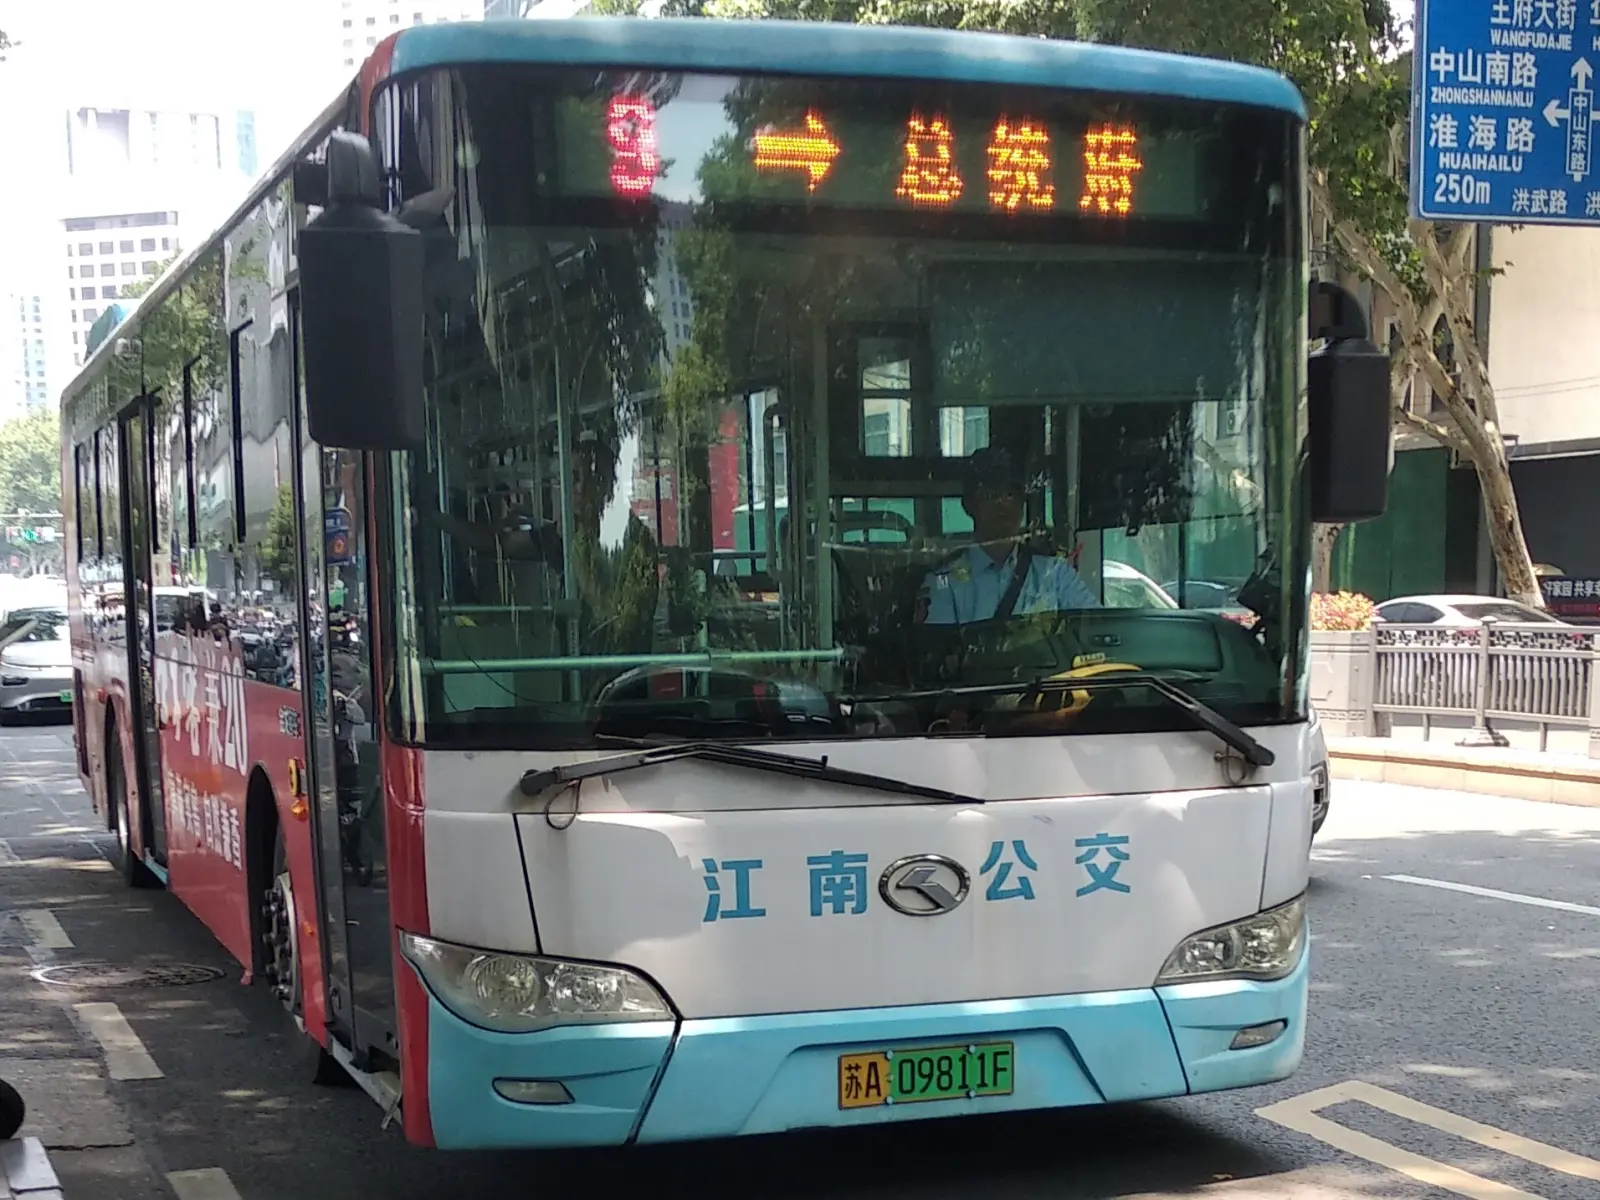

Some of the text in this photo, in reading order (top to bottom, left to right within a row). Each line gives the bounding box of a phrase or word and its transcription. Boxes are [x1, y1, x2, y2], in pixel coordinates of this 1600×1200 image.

[1490, 29, 1572, 51] WANGFUDAJIE
[1430, 46, 1538, 88] 中山南路
[1431, 86, 1534, 108] ZHONGSHANNANLU
[1429, 113, 1536, 153] 淮海路
[1571, 93, 1588, 171] 中山东路
[1438, 151, 1523, 172] HUAIHAILU
[1434, 172, 1491, 205] 250m
[1511, 187, 1568, 215] 洪武路
[702, 832, 1131, 923] 江南 公交
[844, 1051, 1010, 1099] 苏A 09811F
